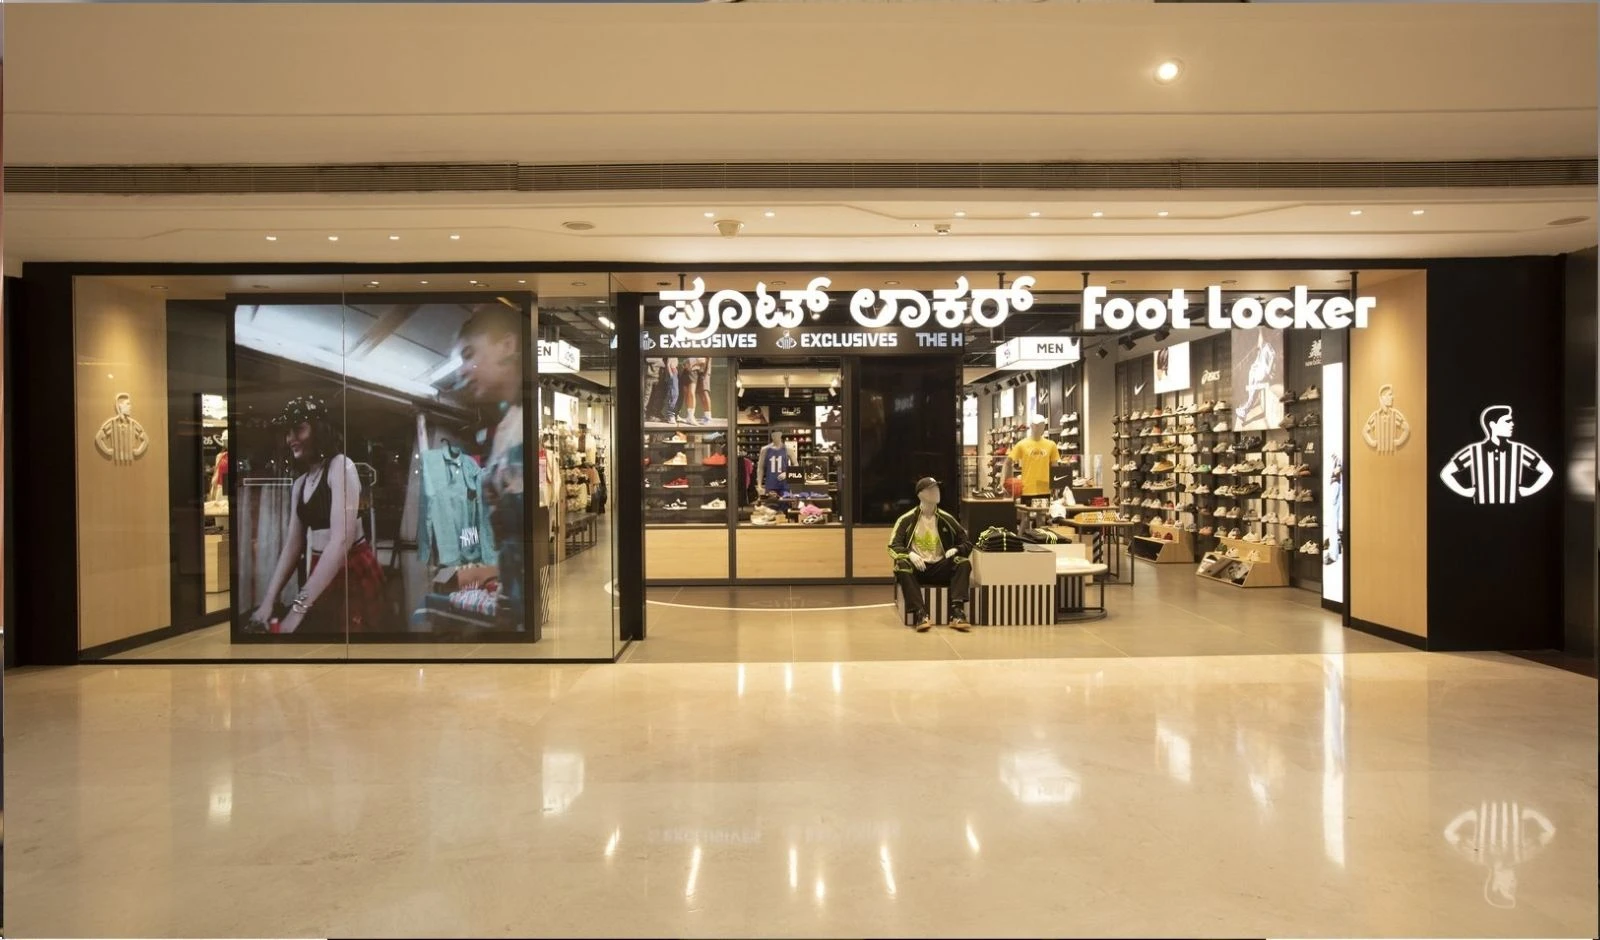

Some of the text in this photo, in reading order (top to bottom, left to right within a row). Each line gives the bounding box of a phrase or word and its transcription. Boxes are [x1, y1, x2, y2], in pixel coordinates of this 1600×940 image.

[850, 275, 1036, 328] ಲಾಕರ್
[1082, 285, 1376, 330] Foot Locker
[800, 333, 898, 347] EXCLUSIVES
[915, 333, 948, 347] THE
[951, 333, 963, 347] H
[1036, 343, 1064, 354] MEN
[769, 455, 783, 473] 11
